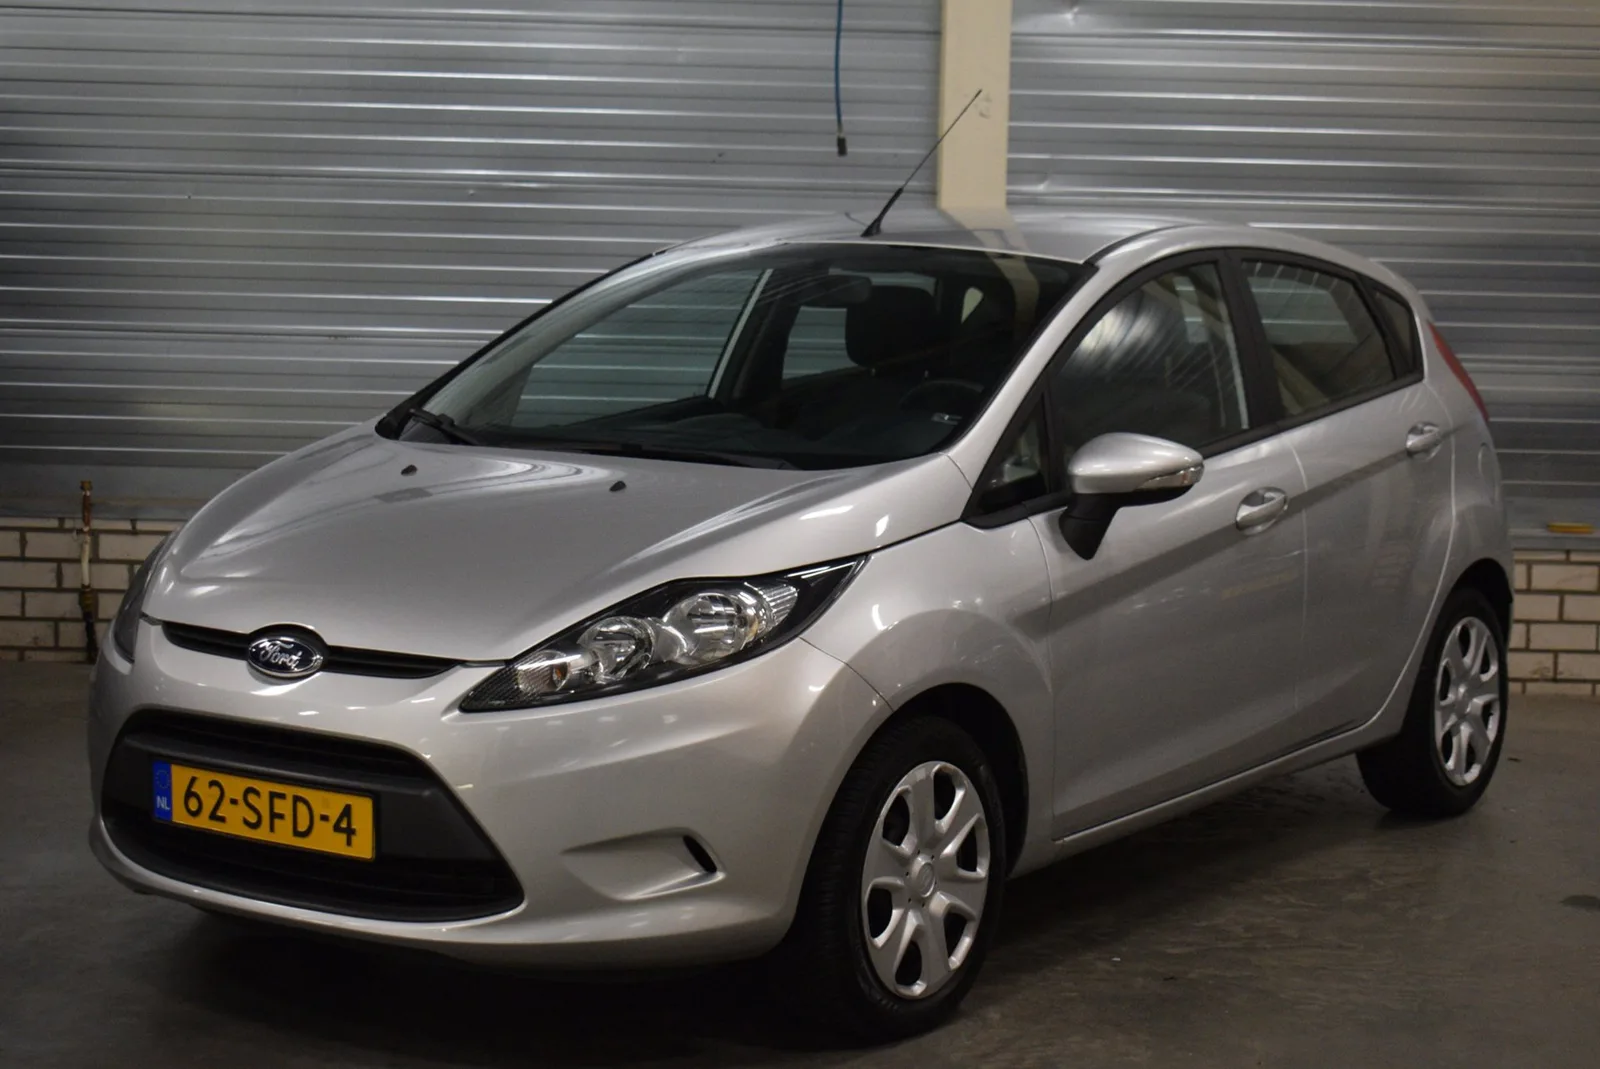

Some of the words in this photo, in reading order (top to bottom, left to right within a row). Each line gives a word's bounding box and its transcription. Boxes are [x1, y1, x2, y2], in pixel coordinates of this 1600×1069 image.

[258, 638, 301, 669] Ford
[156, 796, 171, 811] NL
[184, 776, 357, 846] 62-SFD-4
